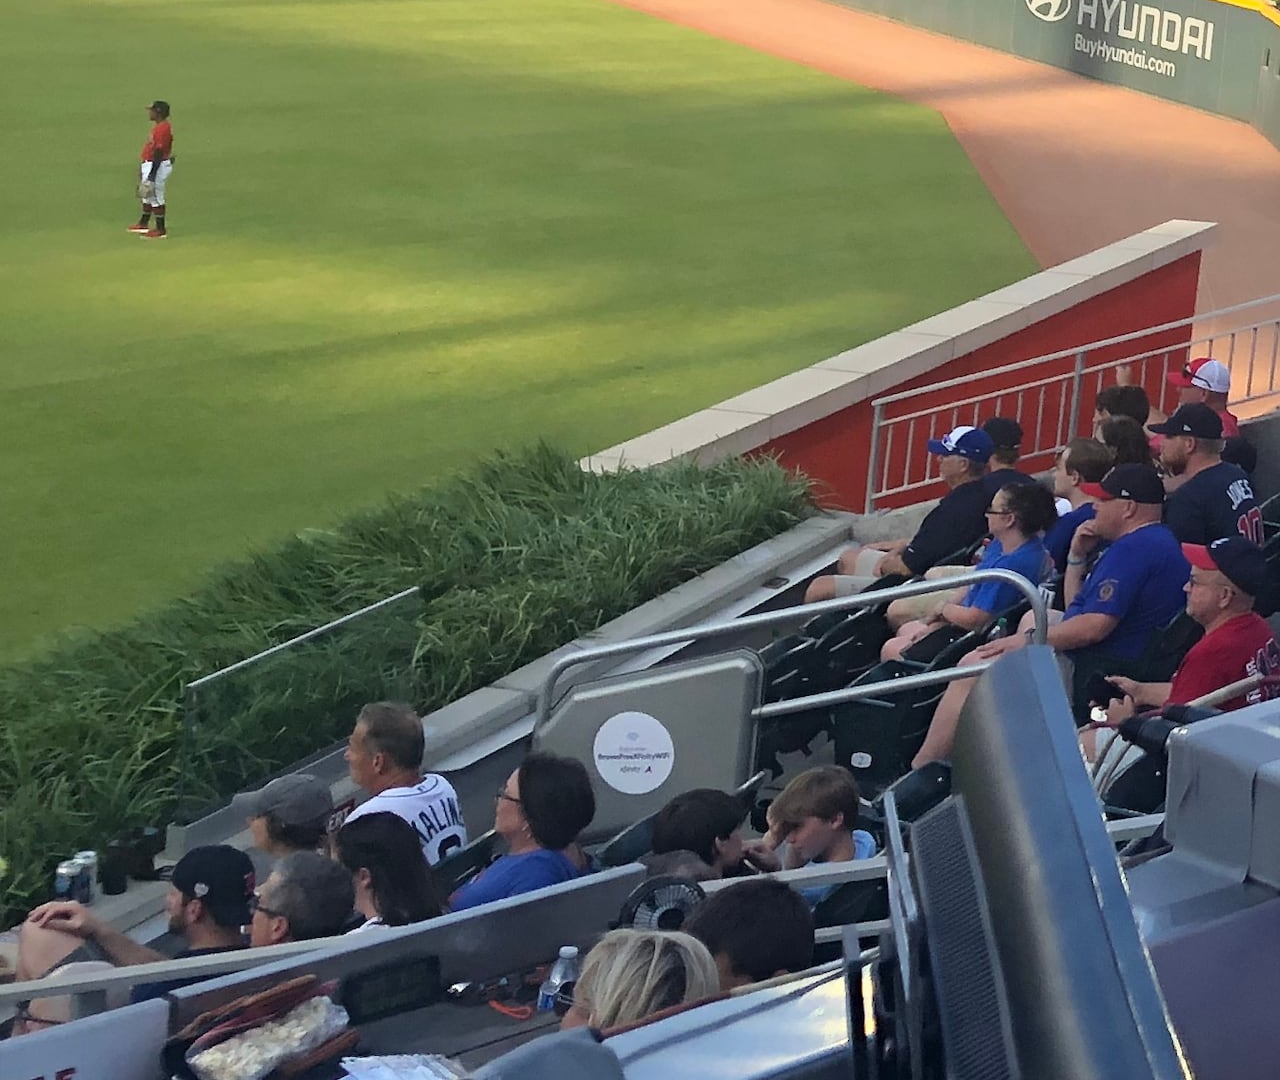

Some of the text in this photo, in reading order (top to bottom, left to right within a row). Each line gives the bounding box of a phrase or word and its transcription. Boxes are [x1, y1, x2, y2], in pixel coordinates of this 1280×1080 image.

[1074, 32, 1176, 78] BuyHyundai.com
[1226, 479, 1255, 511] JONES
[411, 797, 466, 844] ALIN
